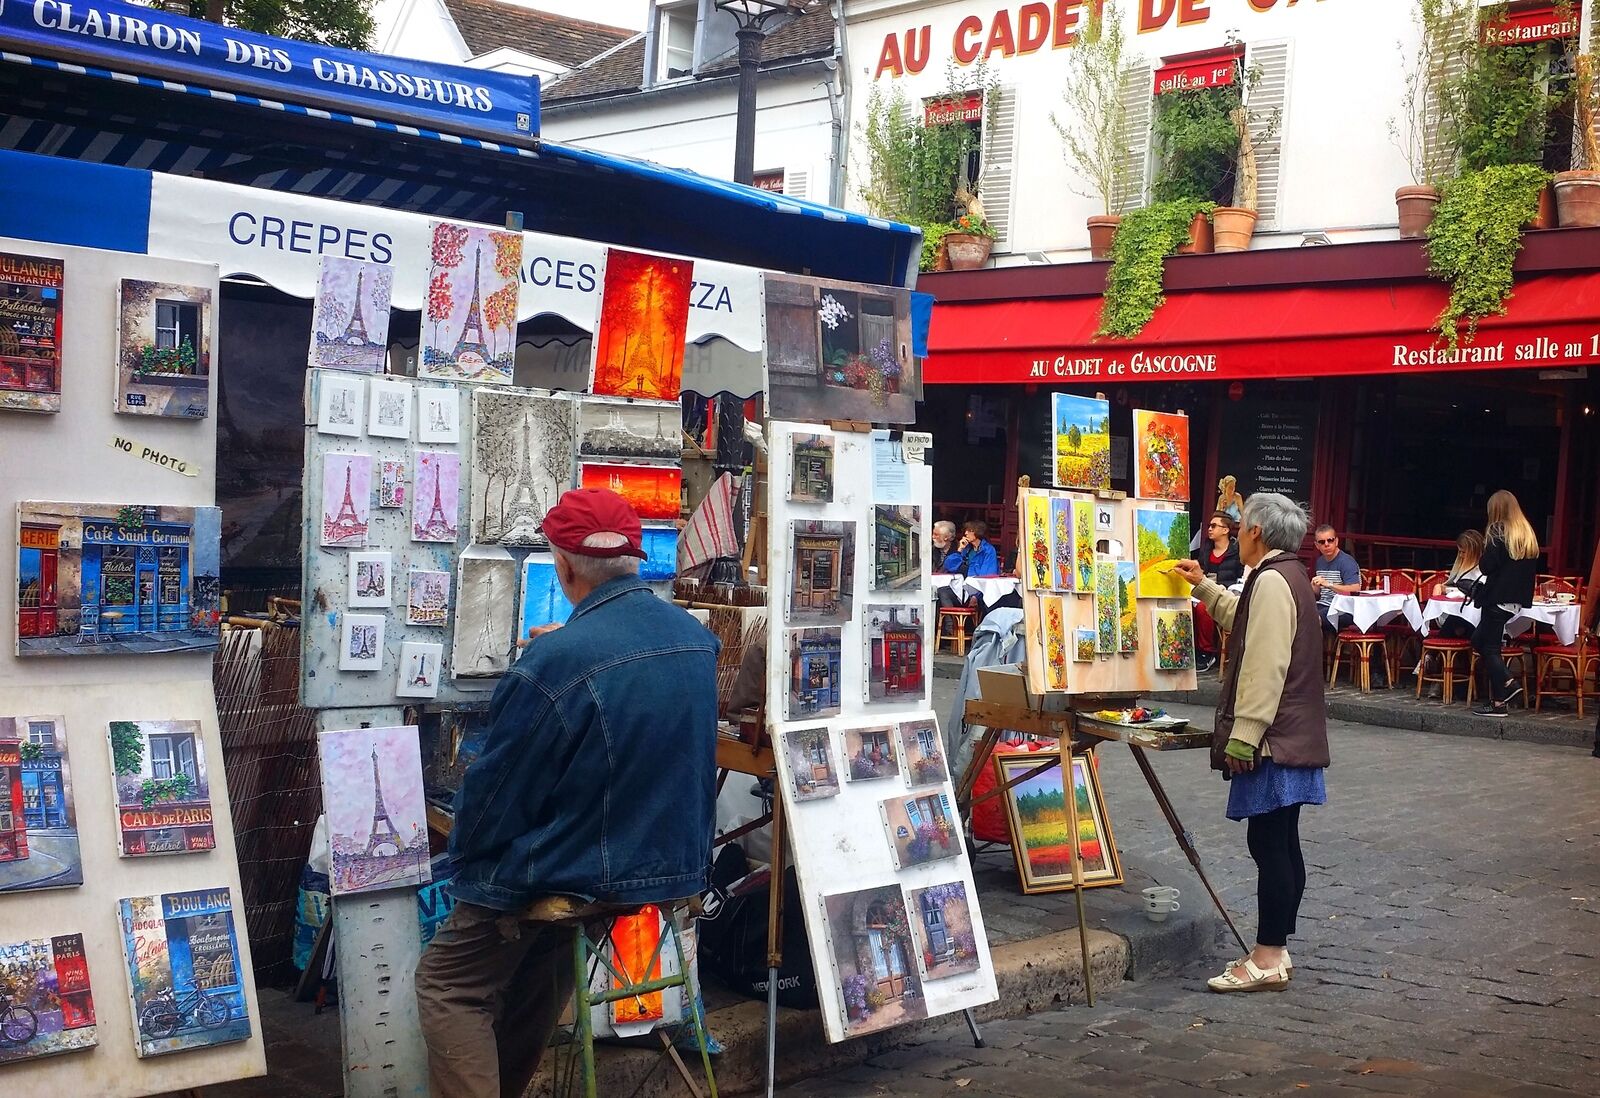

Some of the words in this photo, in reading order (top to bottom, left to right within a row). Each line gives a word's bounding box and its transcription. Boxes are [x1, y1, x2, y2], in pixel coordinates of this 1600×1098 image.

[1486, 17, 1578, 43] Restaurant
[33, 0, 201, 56] CLAIRON
[223, 38, 292, 73] DES
[313, 57, 494, 112] CHASSEURS
[874, 25, 931, 81] AU
[1160, 74, 1188, 91] salle
[1192, 76, 1206, 87] au
[1211, 68, 1228, 84] 1er
[928, 107, 981, 123] Restaurant
[229, 212, 393, 264] CREPES
[1029, 360, 1049, 376] AU
[1054, 355, 1104, 376] CADET
[1107, 360, 1125, 375] de
[1130, 351, 1217, 374] GASCOGNE
[1392, 341, 1505, 366] Restaurant
[1514, 337, 1559, 361] salle
[1564, 343, 1582, 358] au
[114, 437, 133, 452] NO
[141, 447, 187, 473] PHOTO
[84, 525, 114, 541] Café
[117, 526, 149, 543] Saint
[152, 528, 190, 544] Germain
[102, 561, 134, 572] Bistrot
[174, 808, 212, 824] PARIS
[56, 950, 81, 960] PARIS
